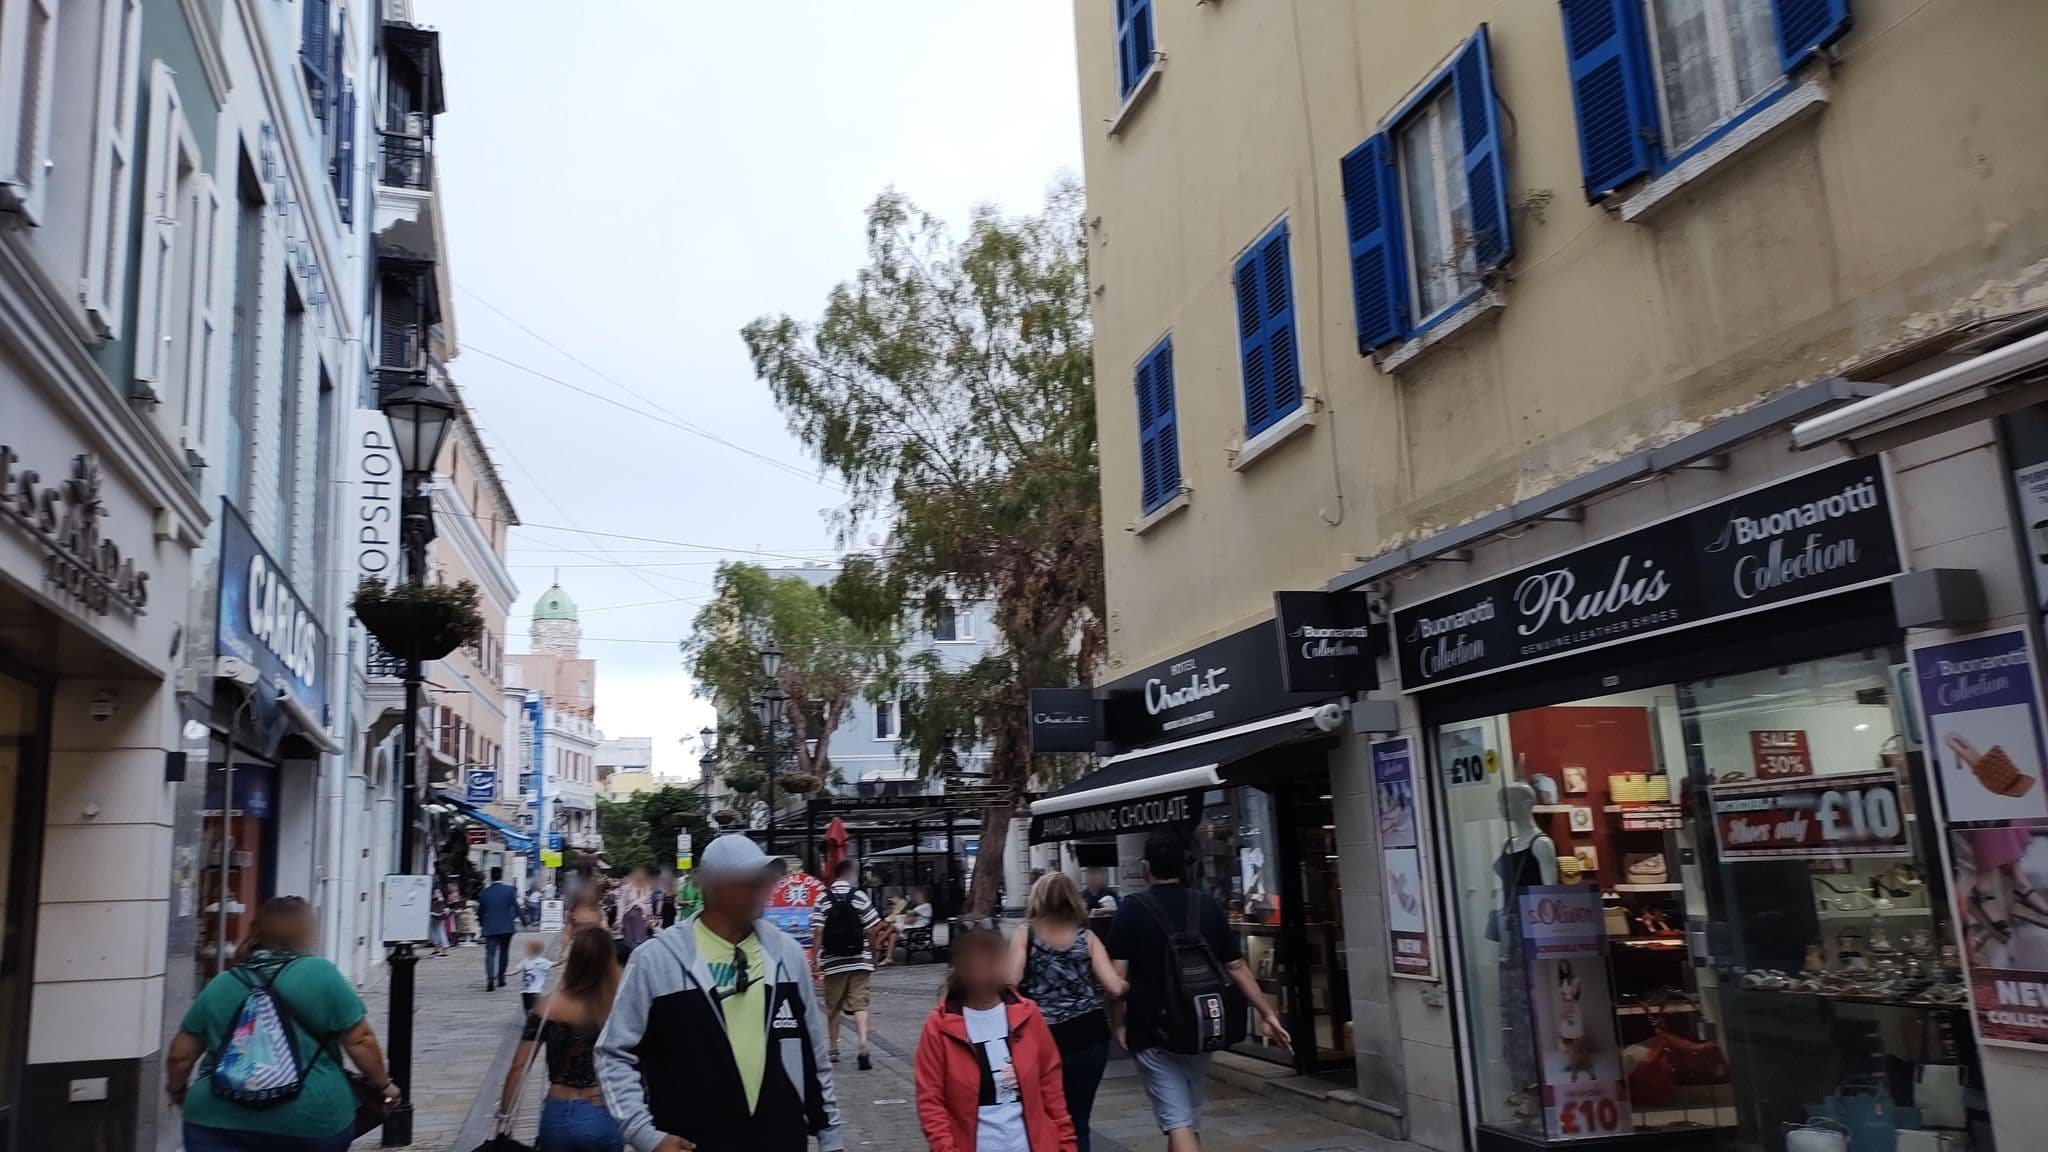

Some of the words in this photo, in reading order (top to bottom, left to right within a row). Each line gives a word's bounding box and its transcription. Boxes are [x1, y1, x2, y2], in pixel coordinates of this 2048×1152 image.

[358, 430, 392, 581] OPSHOP
[1731, 476, 1878, 545] Buonarotti
[1733, 533, 1857, 599] Collection
[1513, 554, 1672, 635] Rubis
[248, 554, 316, 687] CARLOS
[1418, 597, 1495, 639] Buonarotti
[1520, 634, 1572, 655] GENUINE
[1574, 621, 1629, 643] LEATHER
[1631, 609, 1679, 628] SHOES
[1420, 634, 1484, 678] Collection
[1760, 732, 1798, 747] SALE
[1451, 755, 1483, 784] £10
[1760, 756, 1805, 773] -30%
[1119, 796, 1191, 829] CHOCOLATE
[1816, 787, 1899, 841] £10
[1560, 1099, 1618, 1135] £10
